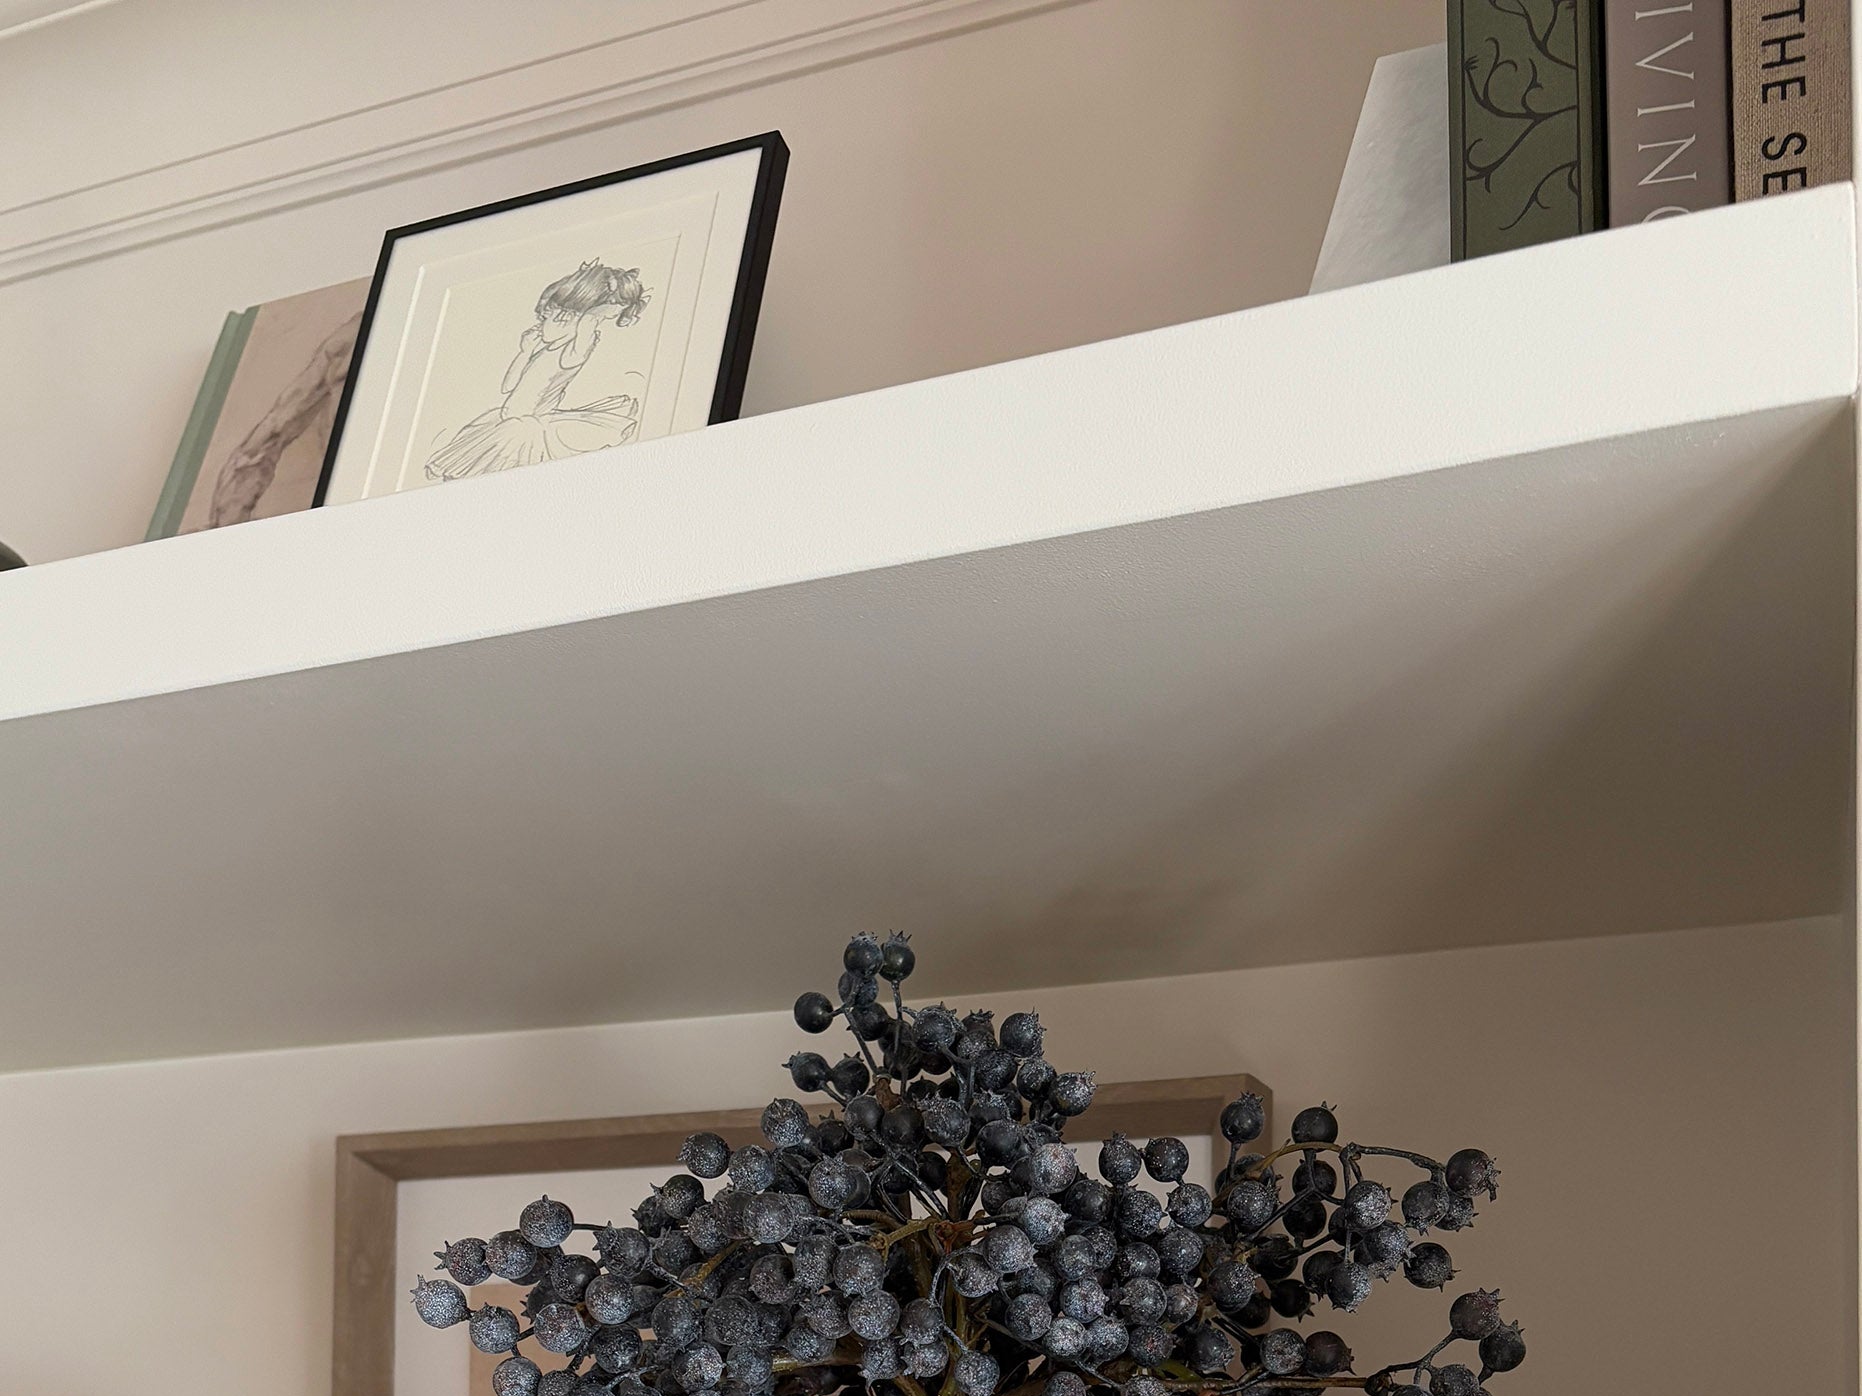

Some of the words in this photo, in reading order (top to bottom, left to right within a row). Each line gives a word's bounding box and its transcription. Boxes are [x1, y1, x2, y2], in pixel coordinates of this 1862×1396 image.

[1761, 0, 1806, 104] THE
[1634, 2, 1697, 223] IVIN
[1761, 132, 1807, 196] SE
